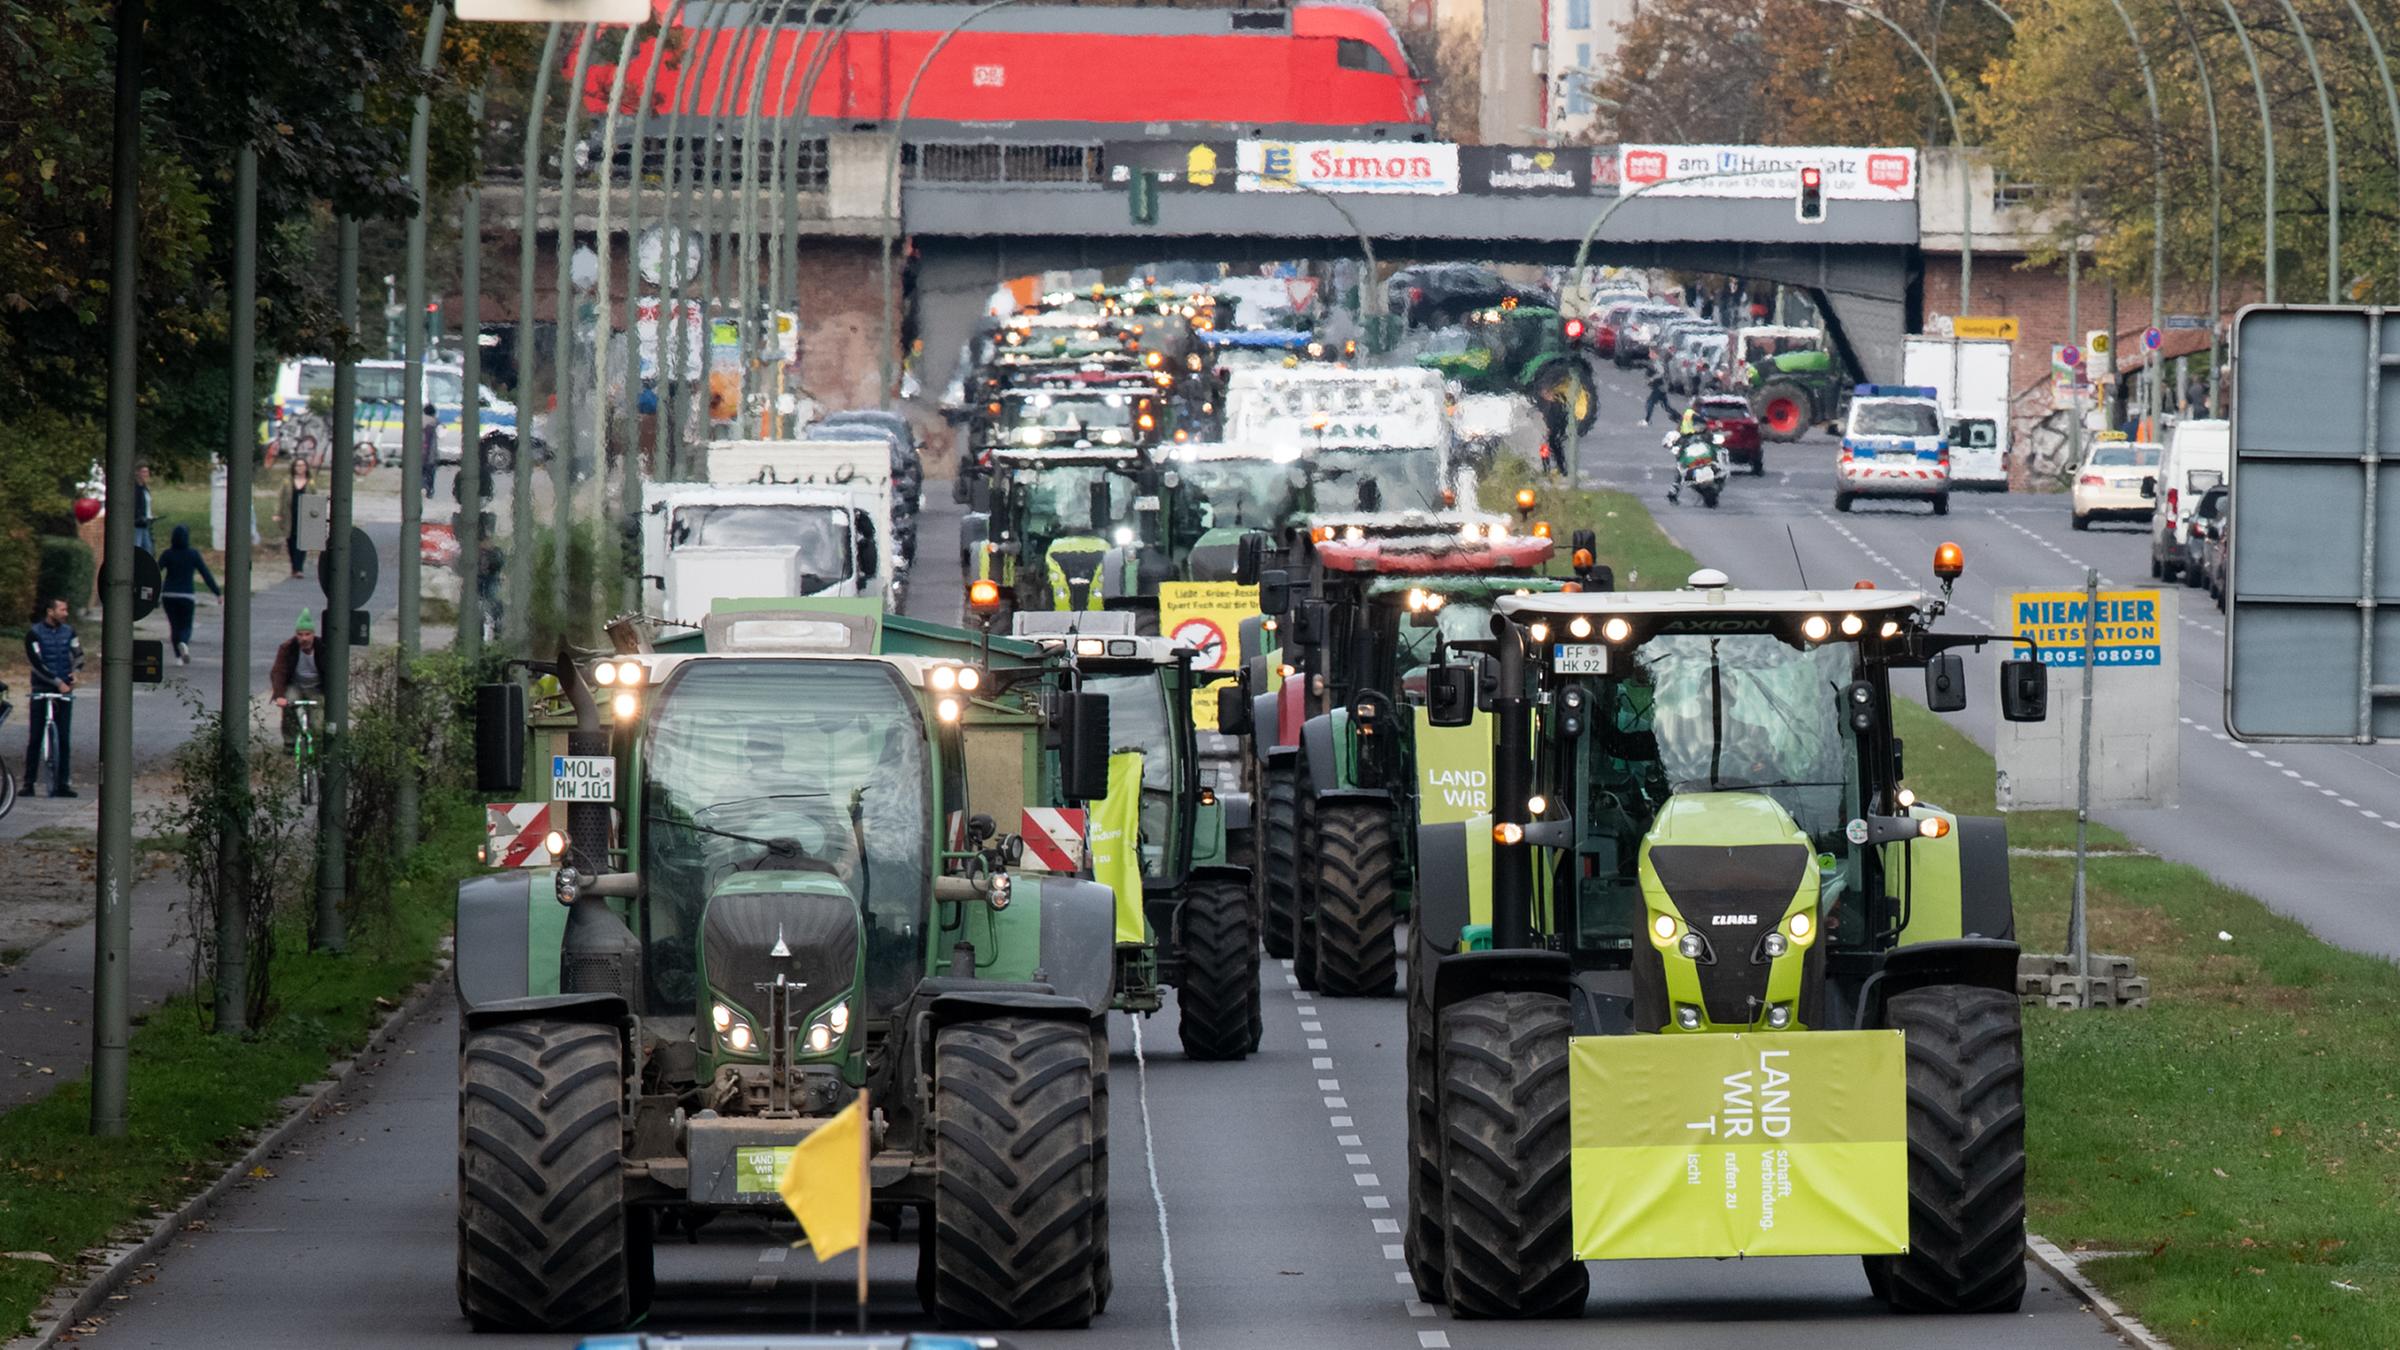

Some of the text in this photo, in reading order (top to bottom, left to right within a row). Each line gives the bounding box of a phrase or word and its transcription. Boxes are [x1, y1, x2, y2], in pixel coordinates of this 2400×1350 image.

[1311, 149, 1432, 178] Simon
[1678, 158, 1709, 171] am
[2019, 600, 2155, 624] NIEMEIER
[1663, 620, 1770, 630] AXION
[1567, 647, 1583, 658] FF
[1562, 661, 1599, 671] HK 92
[564, 760, 600, 777] MOL
[1429, 769, 1487, 787] LAND
[556, 781, 611, 798] MW 101
[1443, 789, 1487, 807] WIR
[1711, 914, 1758, 926] CLAAS
[1760, 1050, 1791, 1138] LAND
[1723, 1070, 1754, 1139] WIR
[1686, 1115, 1716, 1136] T
[749, 1155, 774, 1165] LAND
[755, 1165, 773, 1174] WIR
[1777, 1150, 1792, 1198] schafft
[1726, 1152, 1740, 1209] rufen zu
[1759, 1150, 1776, 1231] Verbindung.
